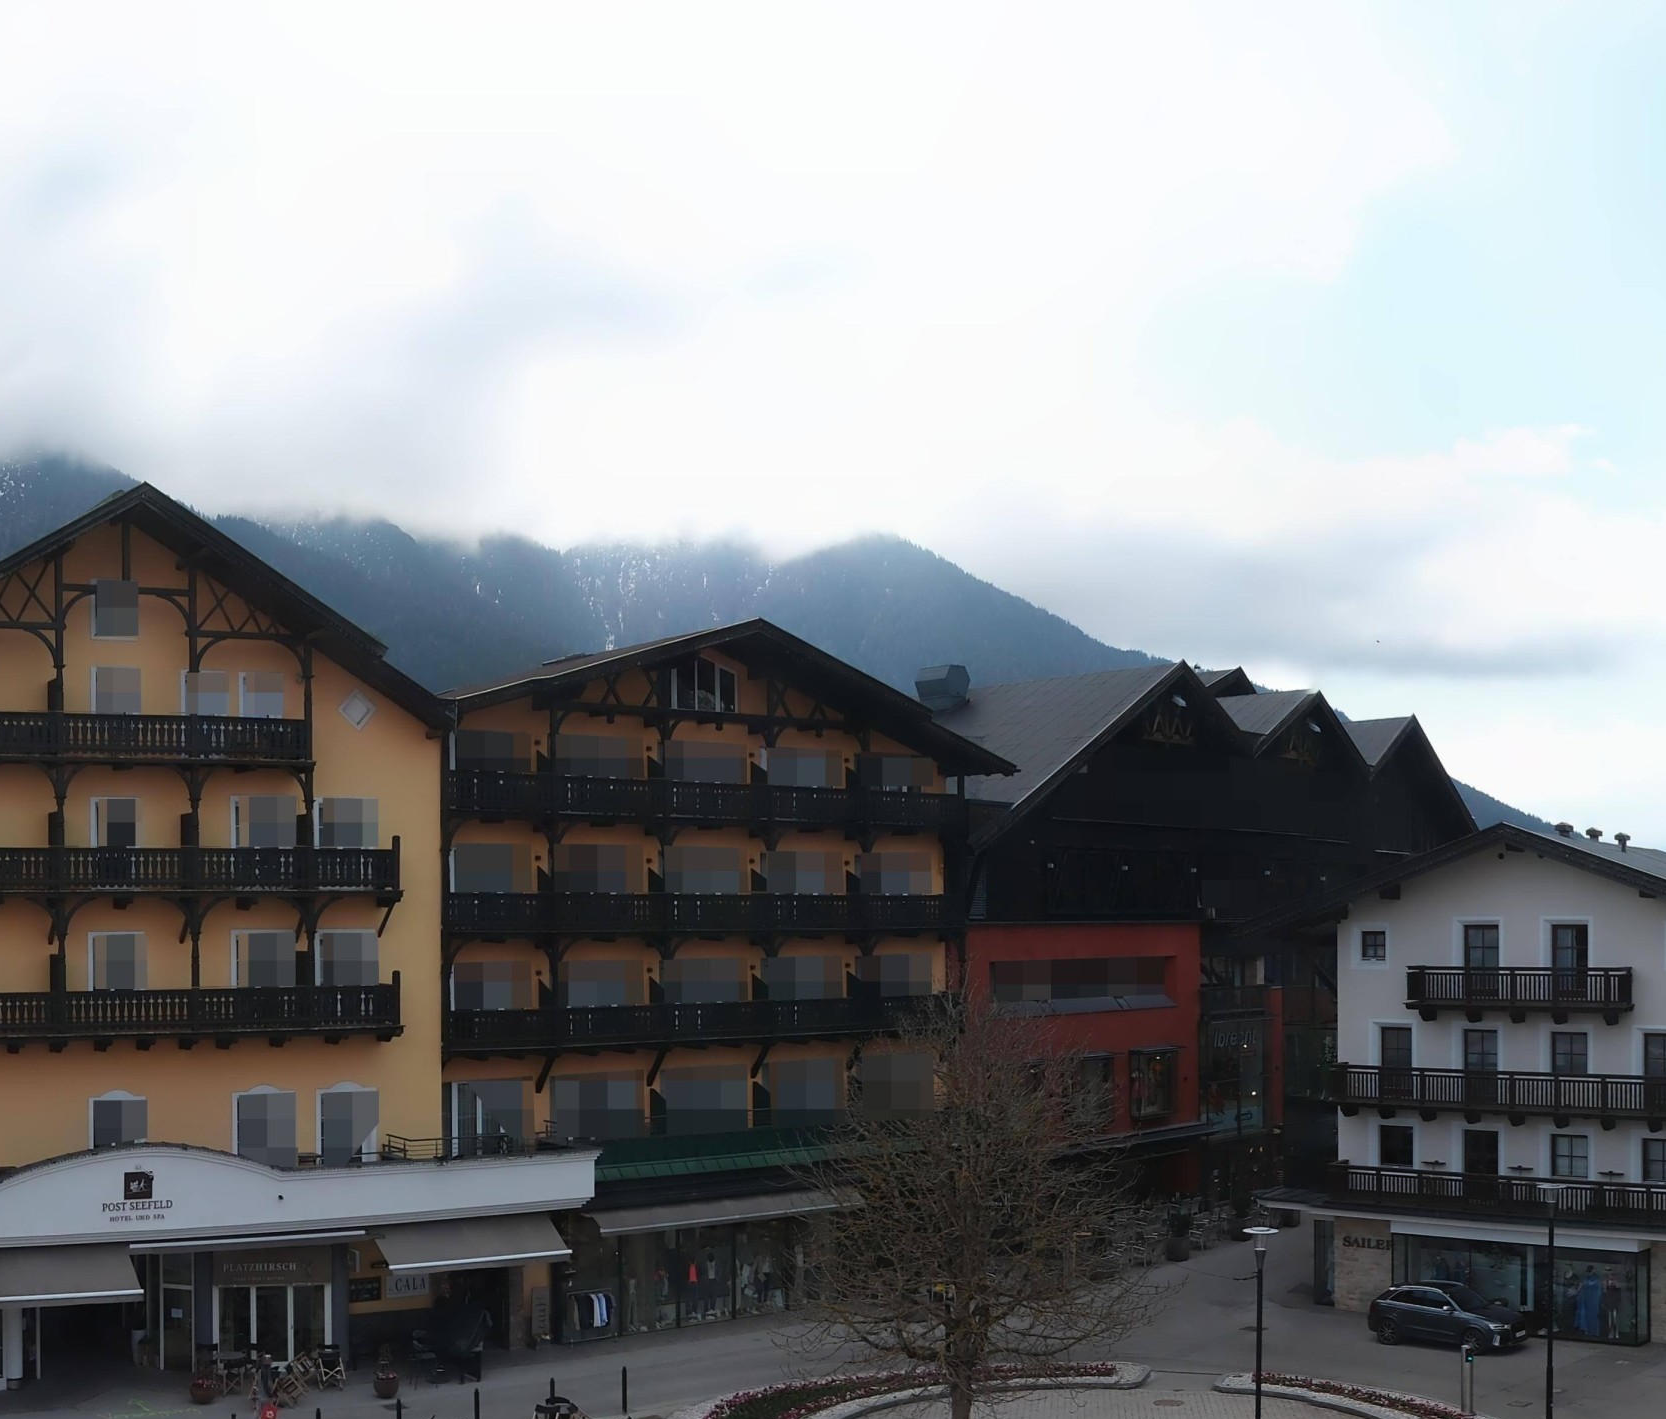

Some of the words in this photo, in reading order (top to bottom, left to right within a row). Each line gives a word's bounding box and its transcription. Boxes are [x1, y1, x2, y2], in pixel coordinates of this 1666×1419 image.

[1214, 1028, 1256, 1048] lbrecht
[102, 1202, 128, 1213] POST
[129, 1200, 174, 1211] SEEFELD
[109, 1215, 133, 1223] HOTEL
[1342, 1235, 1396, 1251] SAILER
[223, 1262, 297, 1273] PLATZHIRSCH
